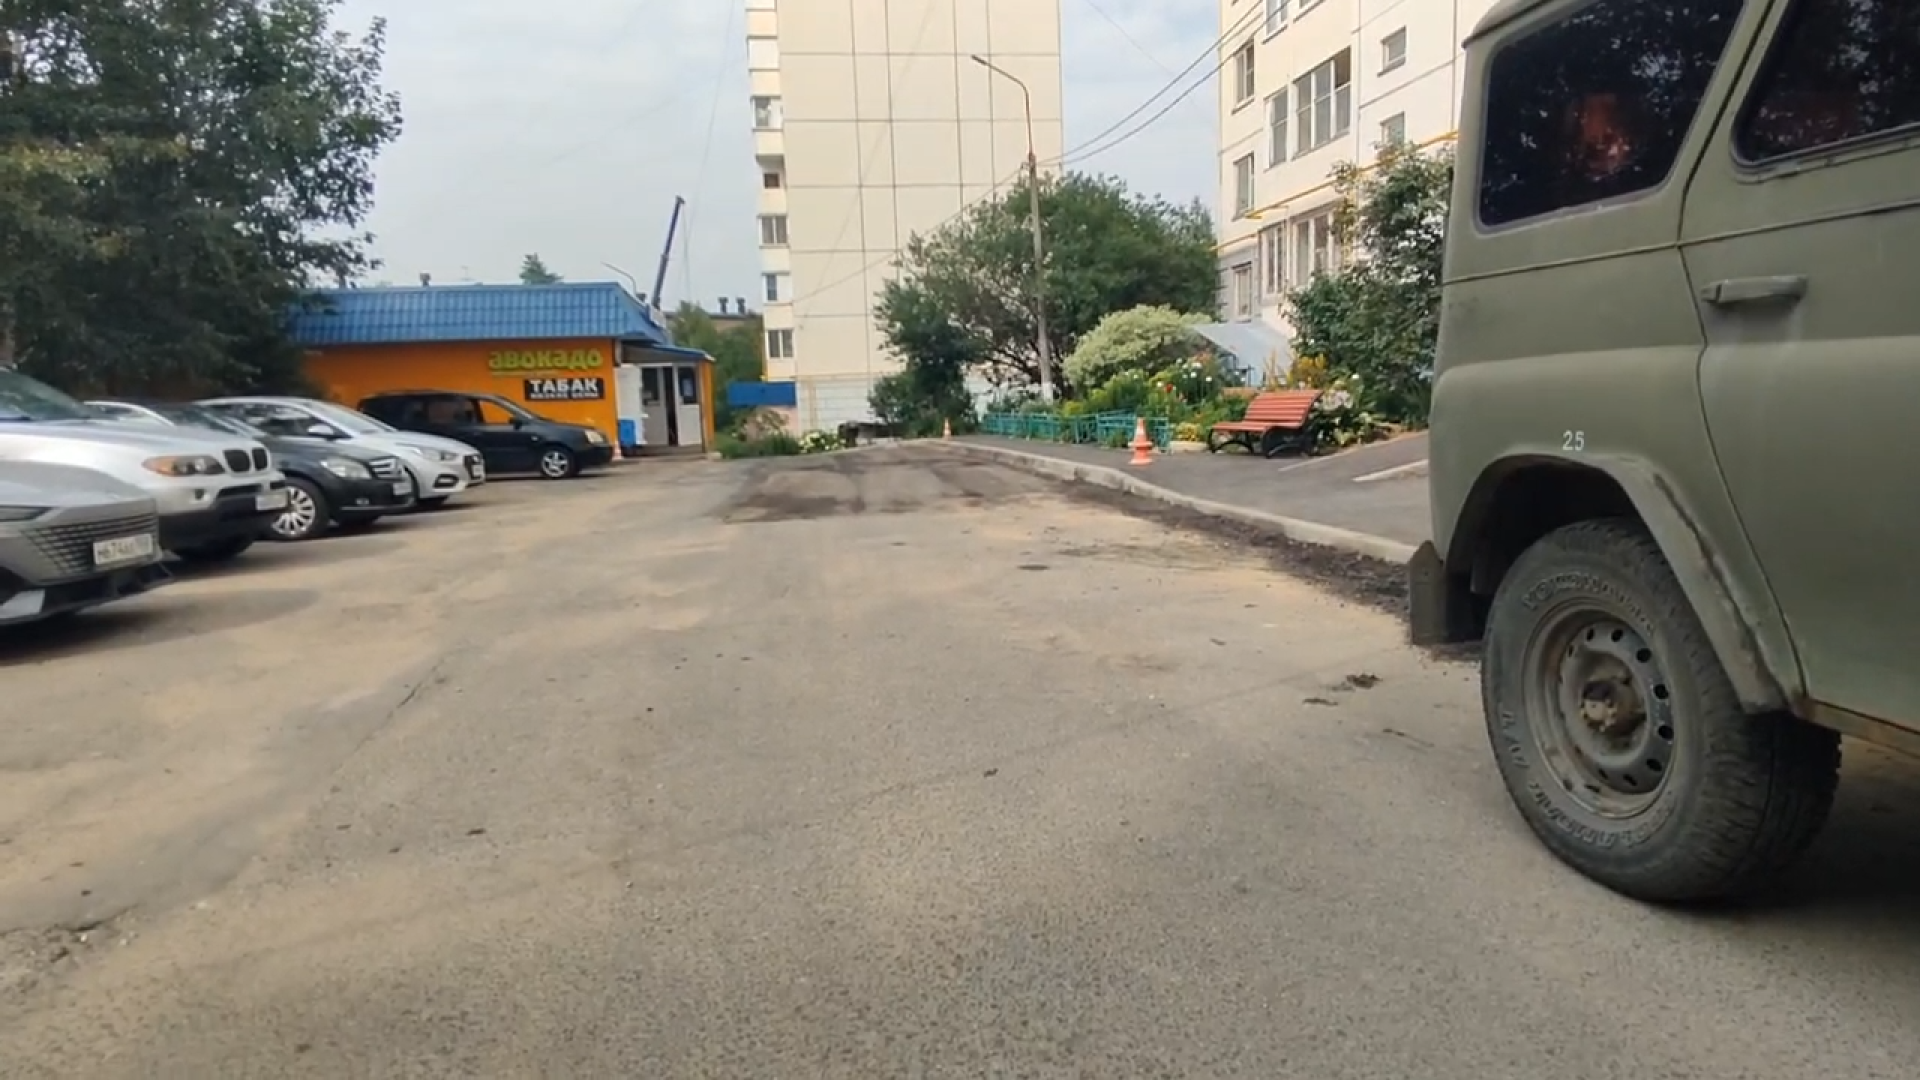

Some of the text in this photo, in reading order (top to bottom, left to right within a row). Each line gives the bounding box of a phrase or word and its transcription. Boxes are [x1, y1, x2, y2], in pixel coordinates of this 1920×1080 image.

[488, 349, 603, 370] авокадо
[529, 378, 598, 393] ТАБАК
[1562, 430, 1585, 451] 25
